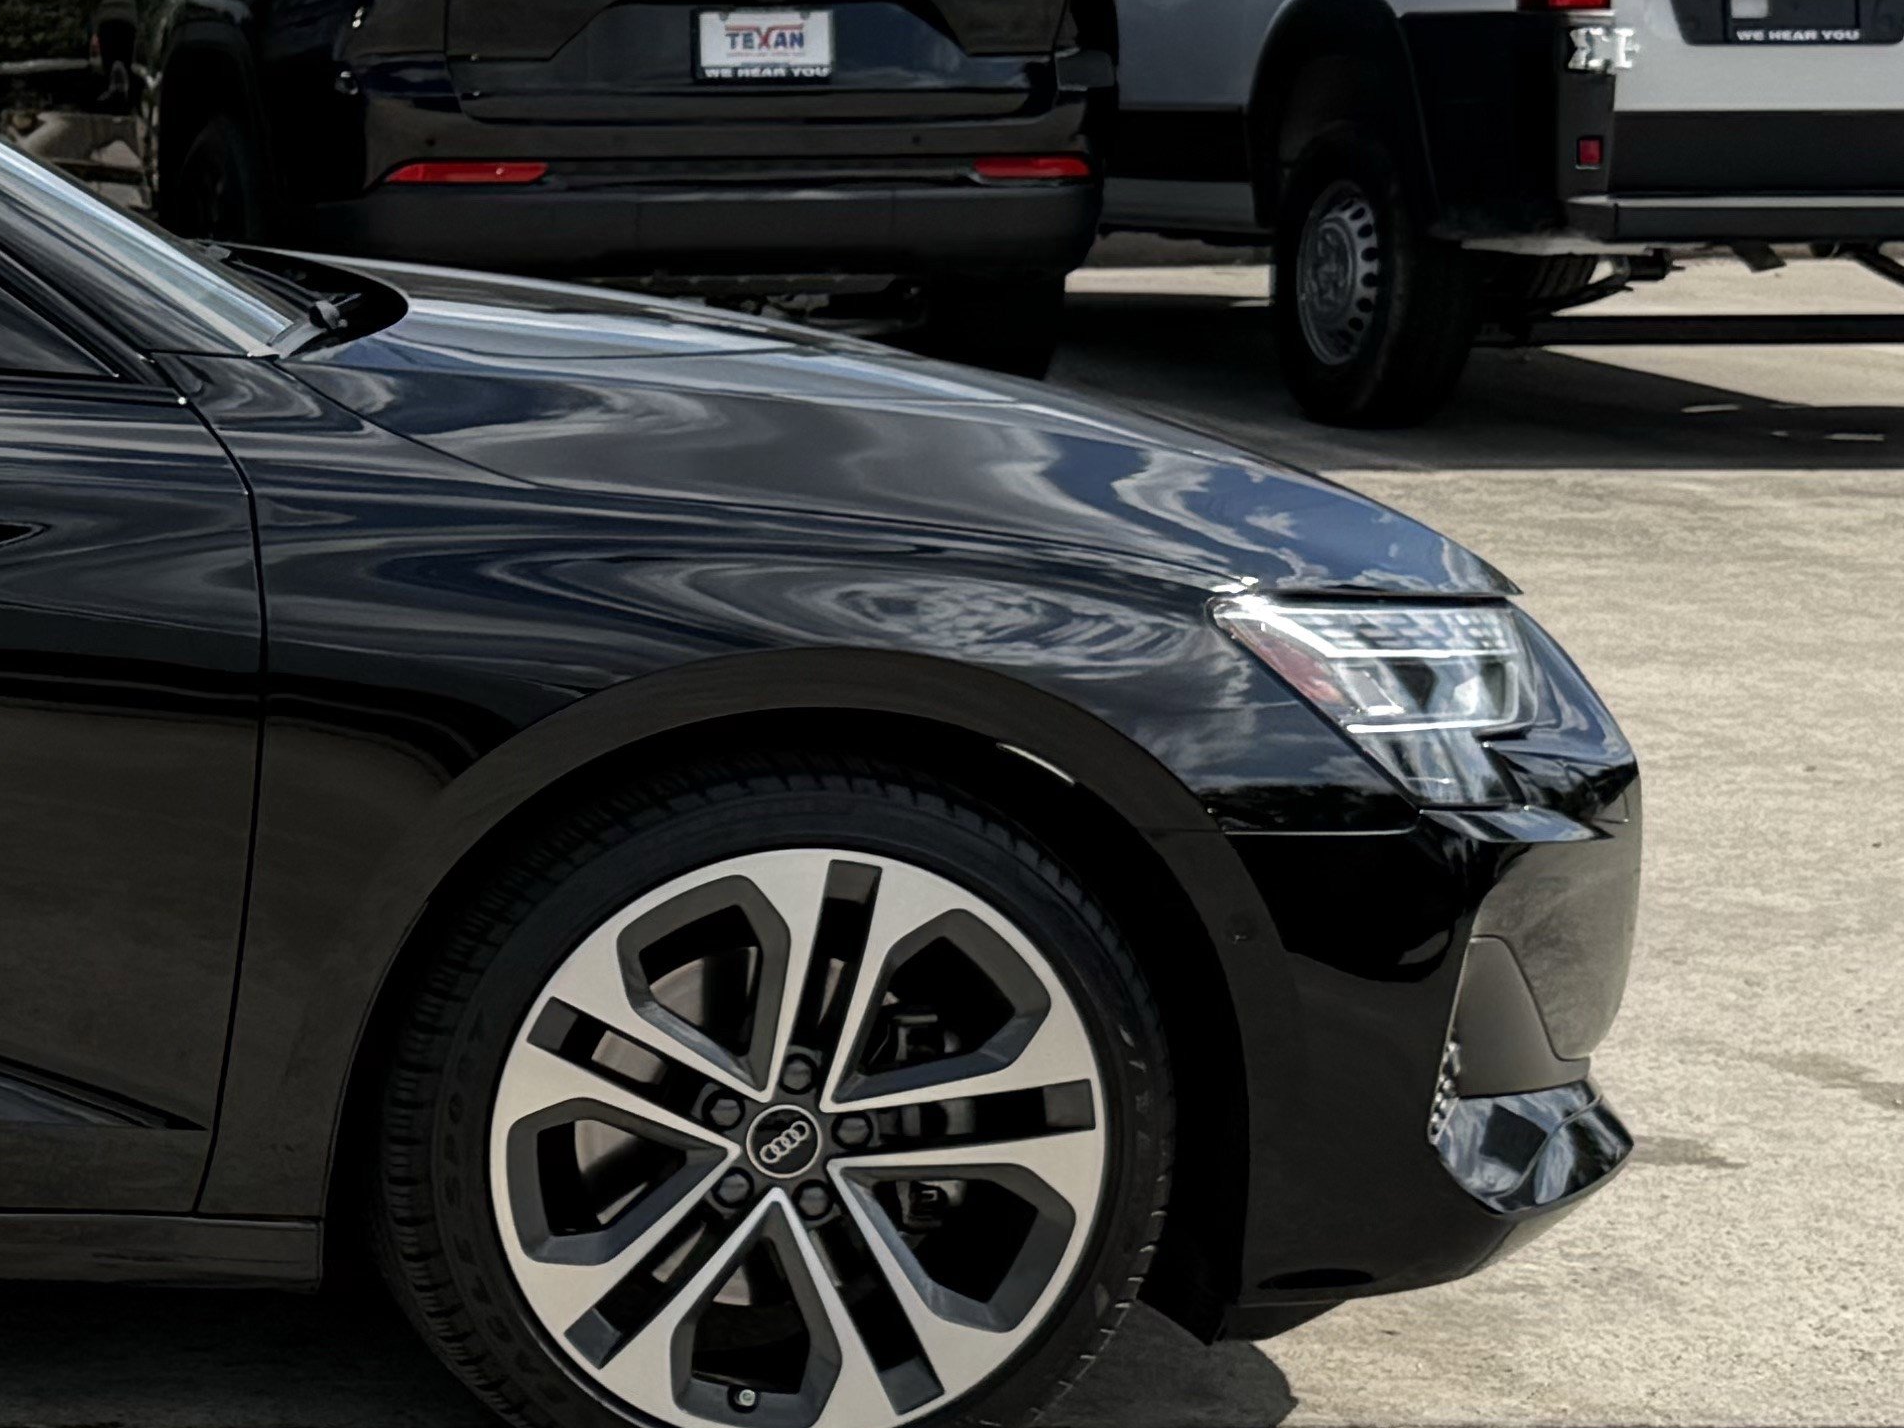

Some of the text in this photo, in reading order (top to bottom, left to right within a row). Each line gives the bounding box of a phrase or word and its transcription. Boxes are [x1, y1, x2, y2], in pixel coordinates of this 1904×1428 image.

[725, 26, 804, 49] TEXAN
[1736, 29, 1860, 41] WE HEAR YOU
[705, 66, 832, 78] WE HEAR YOU
